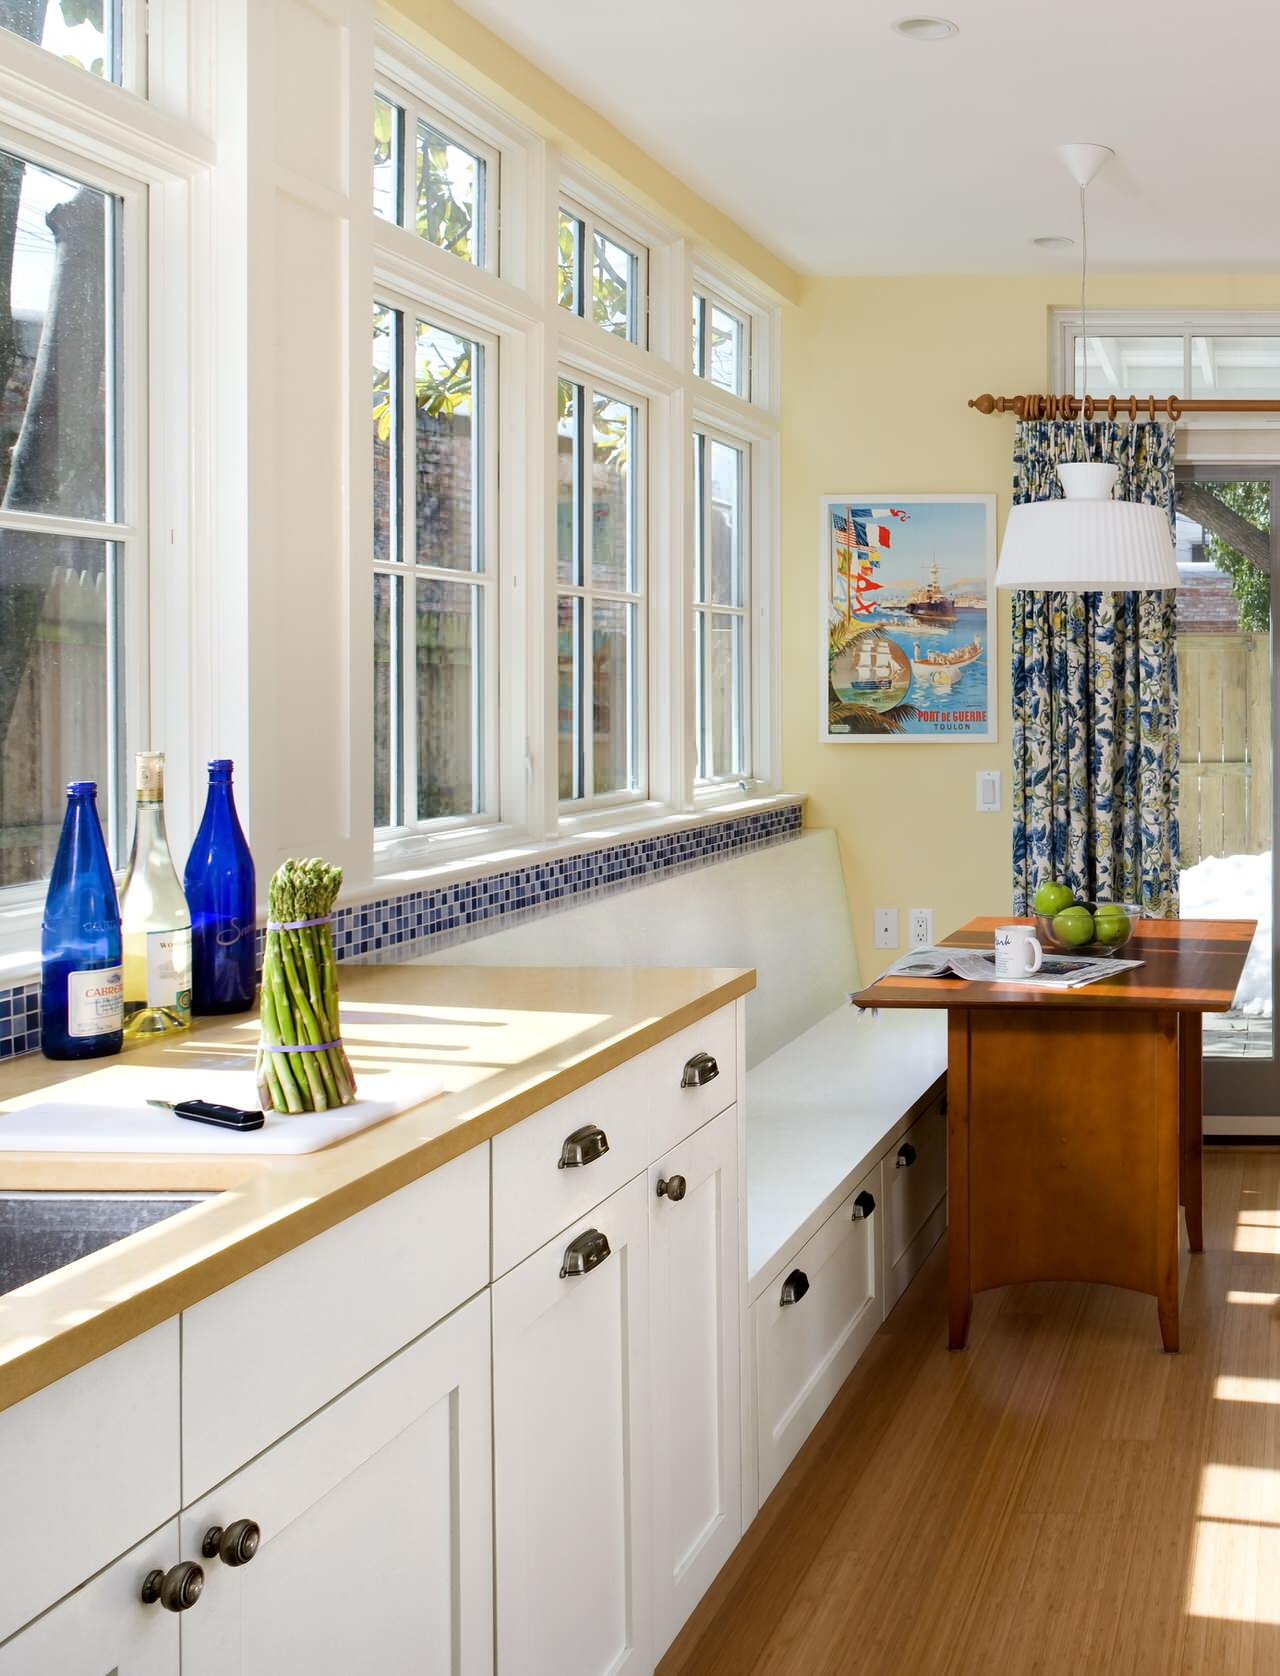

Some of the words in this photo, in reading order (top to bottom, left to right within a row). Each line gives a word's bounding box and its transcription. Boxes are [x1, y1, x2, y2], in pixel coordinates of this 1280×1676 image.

[917, 710, 938, 722] PORT
[941, 711, 950, 722] DE
[952, 710, 987, 722] GUERRE
